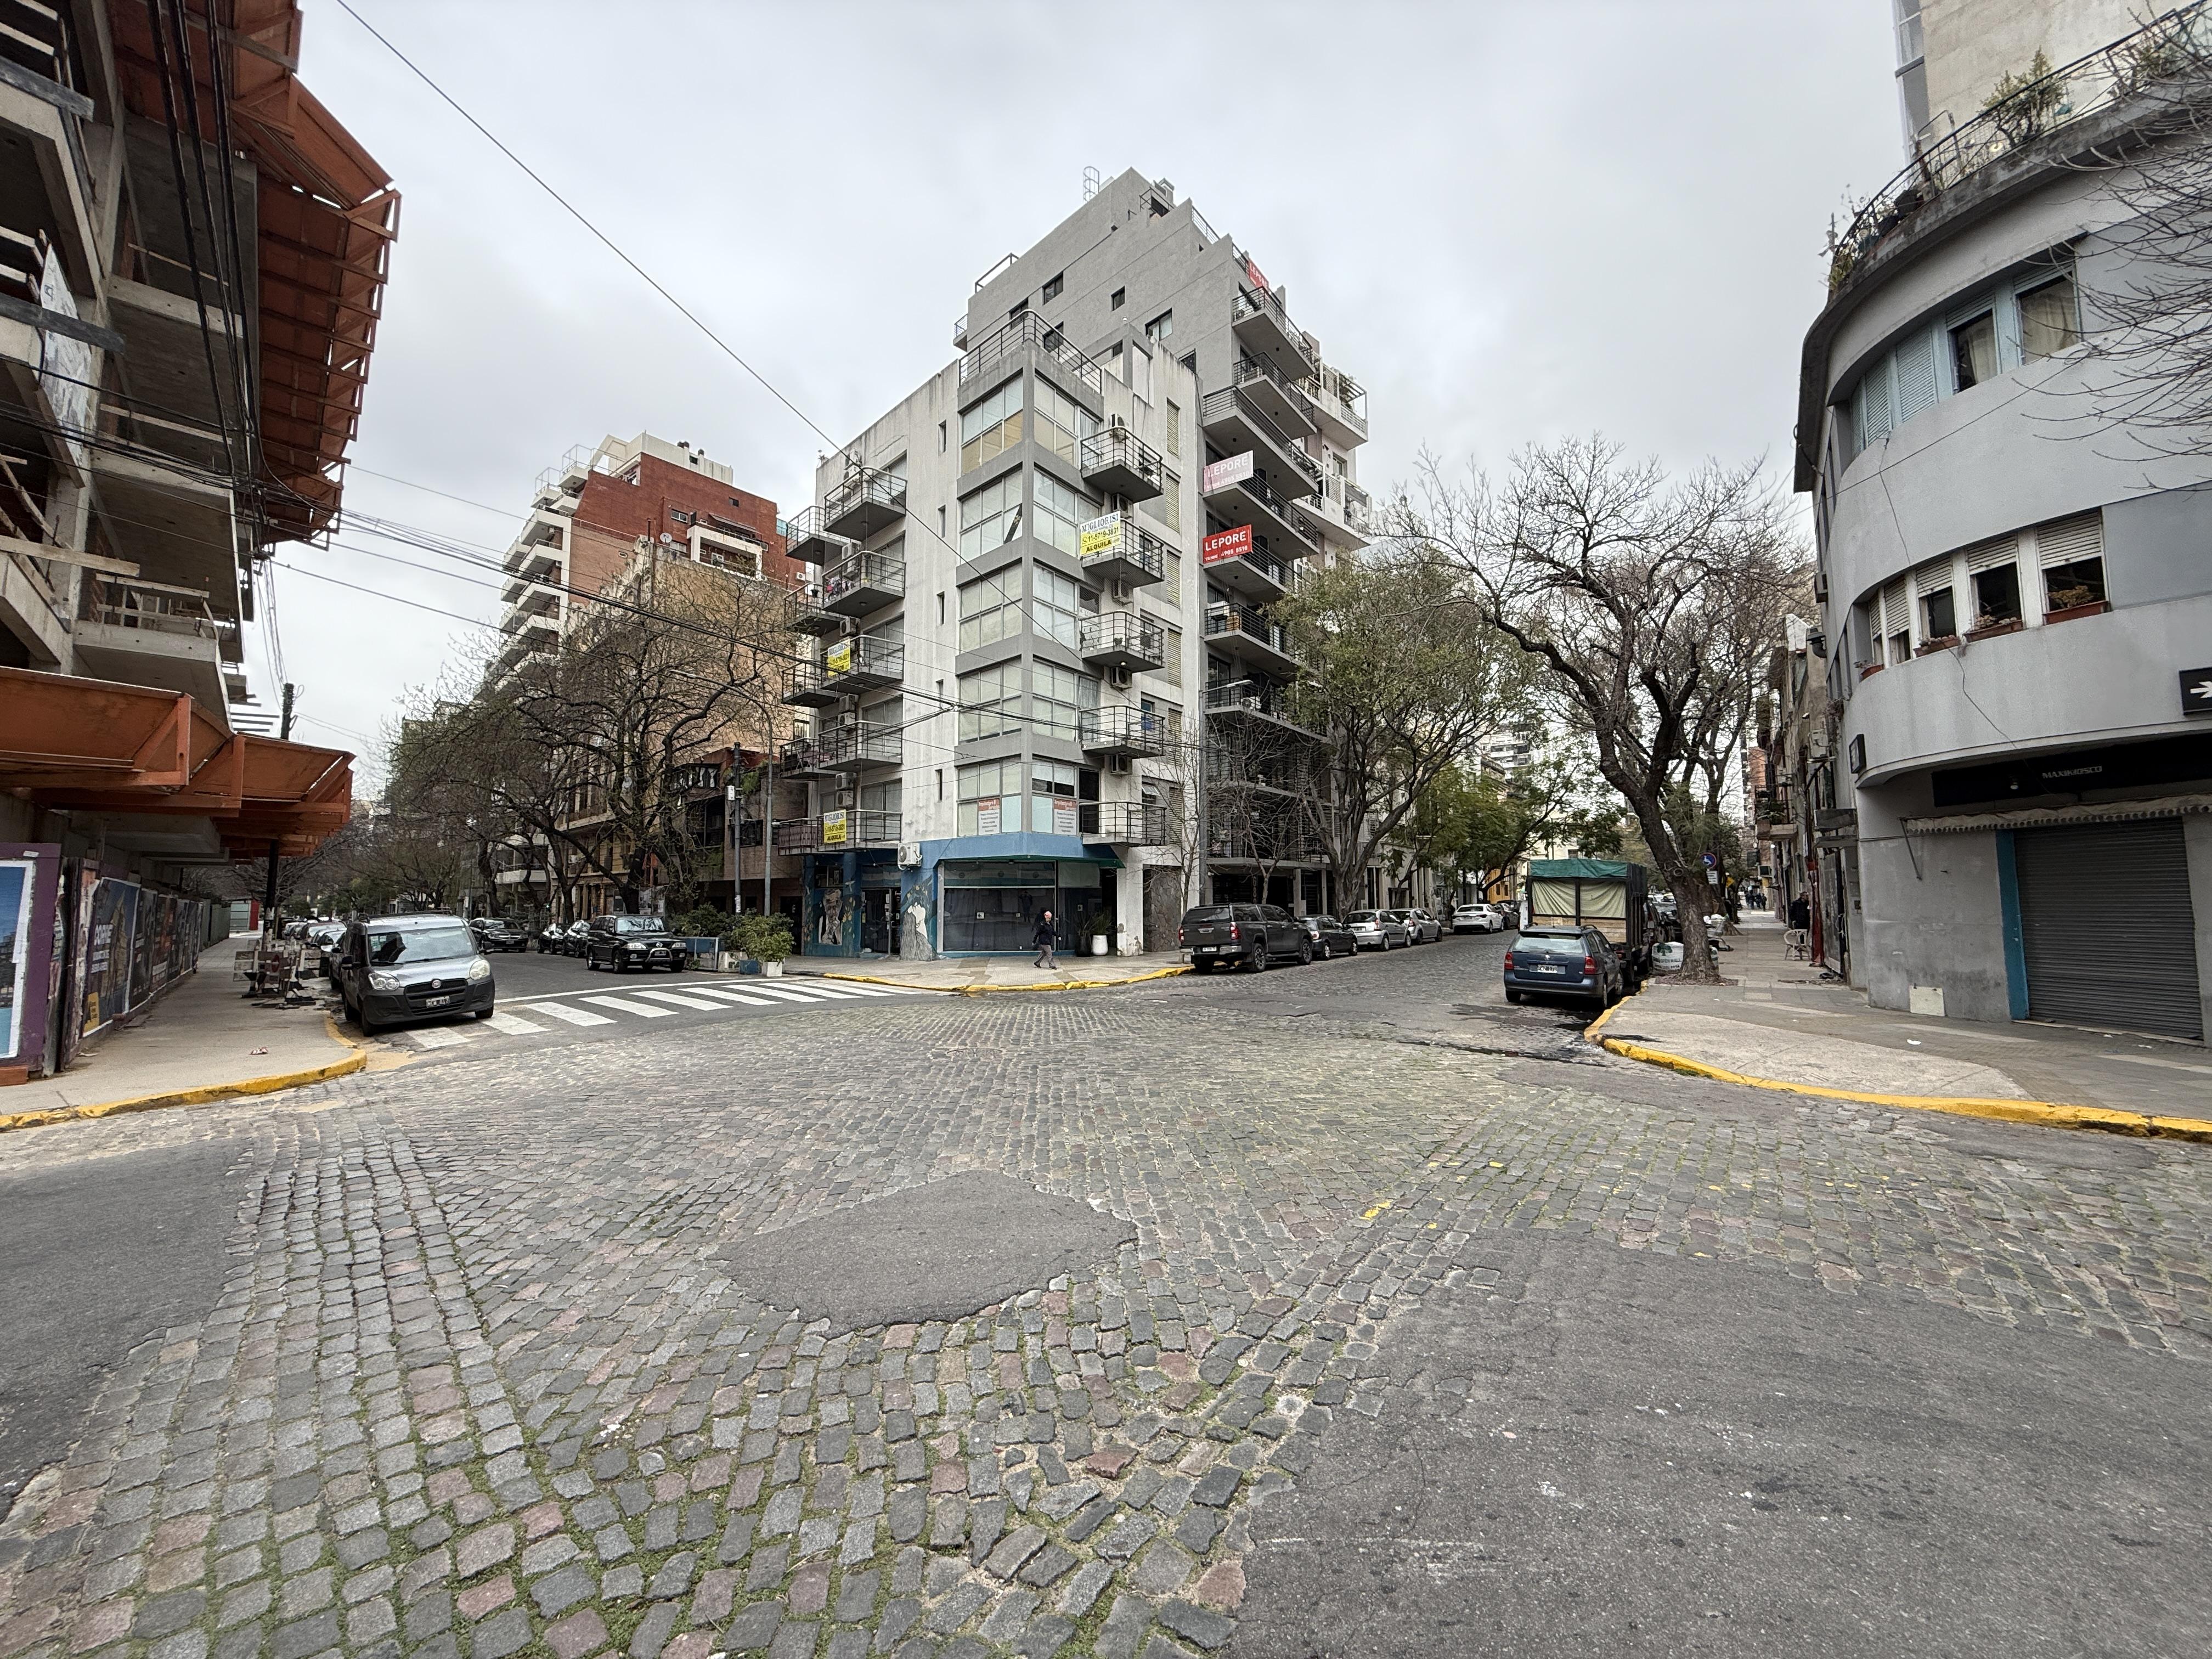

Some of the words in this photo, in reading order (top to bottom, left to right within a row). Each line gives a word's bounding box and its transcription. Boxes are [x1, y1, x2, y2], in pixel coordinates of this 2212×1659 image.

[1207, 456, 1248, 477] LEPORE
[1082, 514, 1119, 532] MIGLIORISI
[1086, 540, 1111, 552] ALQUILA
[1205, 531, 1246, 551] LEPORE
